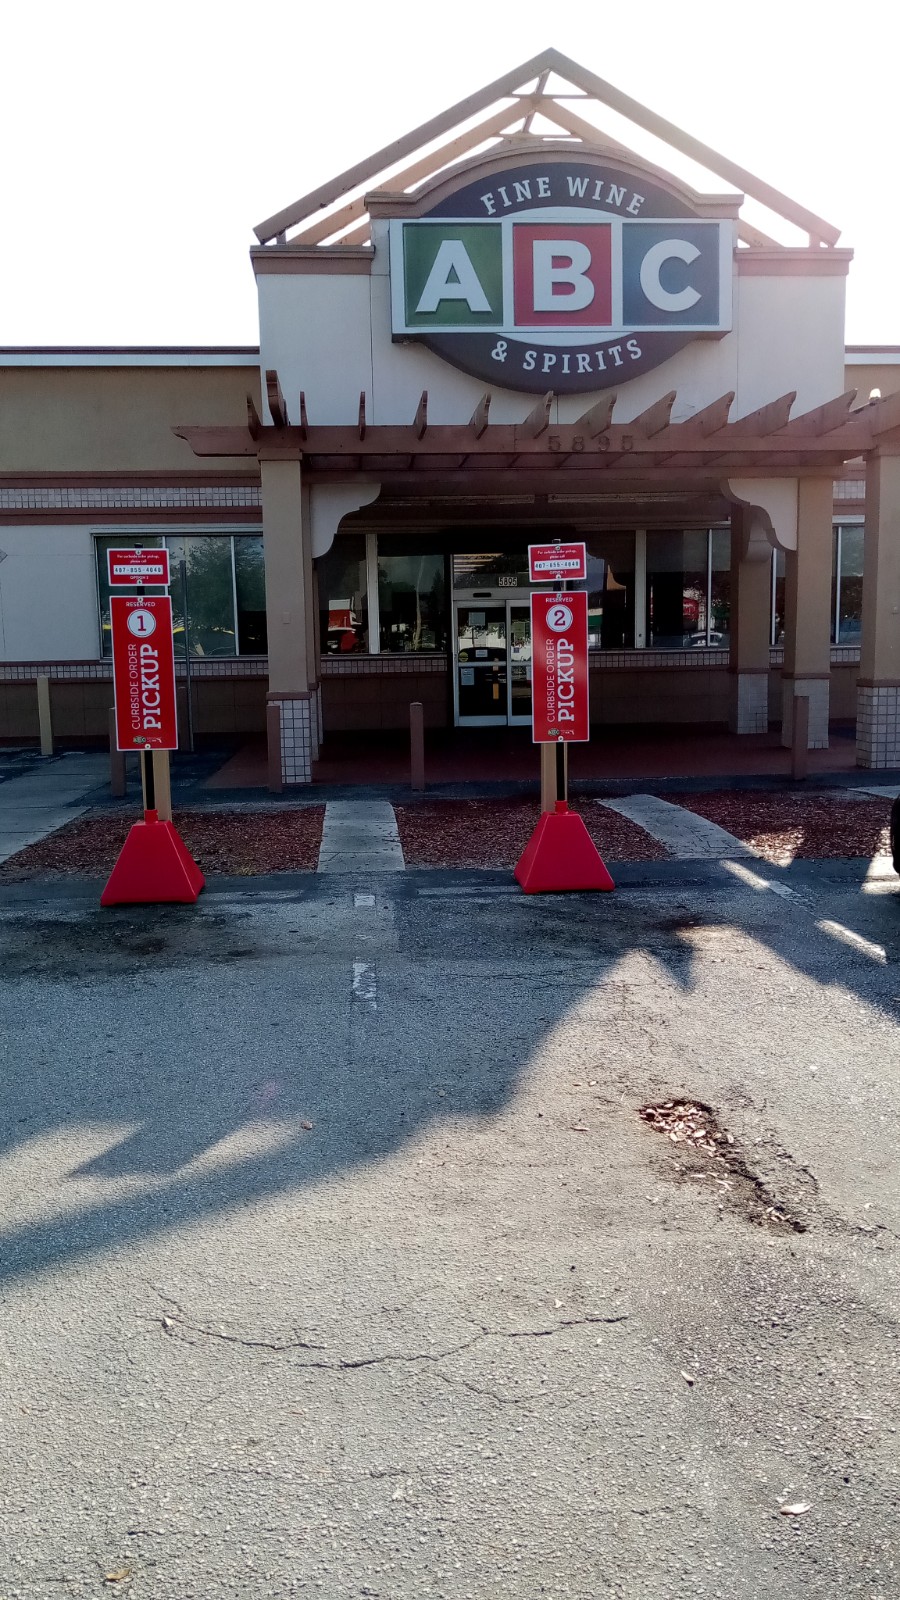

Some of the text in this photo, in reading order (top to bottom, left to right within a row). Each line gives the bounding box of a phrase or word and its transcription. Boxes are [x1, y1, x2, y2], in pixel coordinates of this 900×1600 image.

[480, 176, 646, 215] FINE WINE
[414, 239, 702, 313] ABC
[491, 339, 643, 374] & SPIRITS
[548, 435, 633, 452] 5895
[499, 577, 518, 587] 5895
[137, 615, 147, 632] 1
[553, 609, 566, 626] 2
[127, 643, 141, 730] CURBSIDE ORDER
[140, 643, 162, 730] PICKUP
[545, 638, 556, 722] CURBSIDE ORDER
[557, 638, 575, 722] PICKUP
